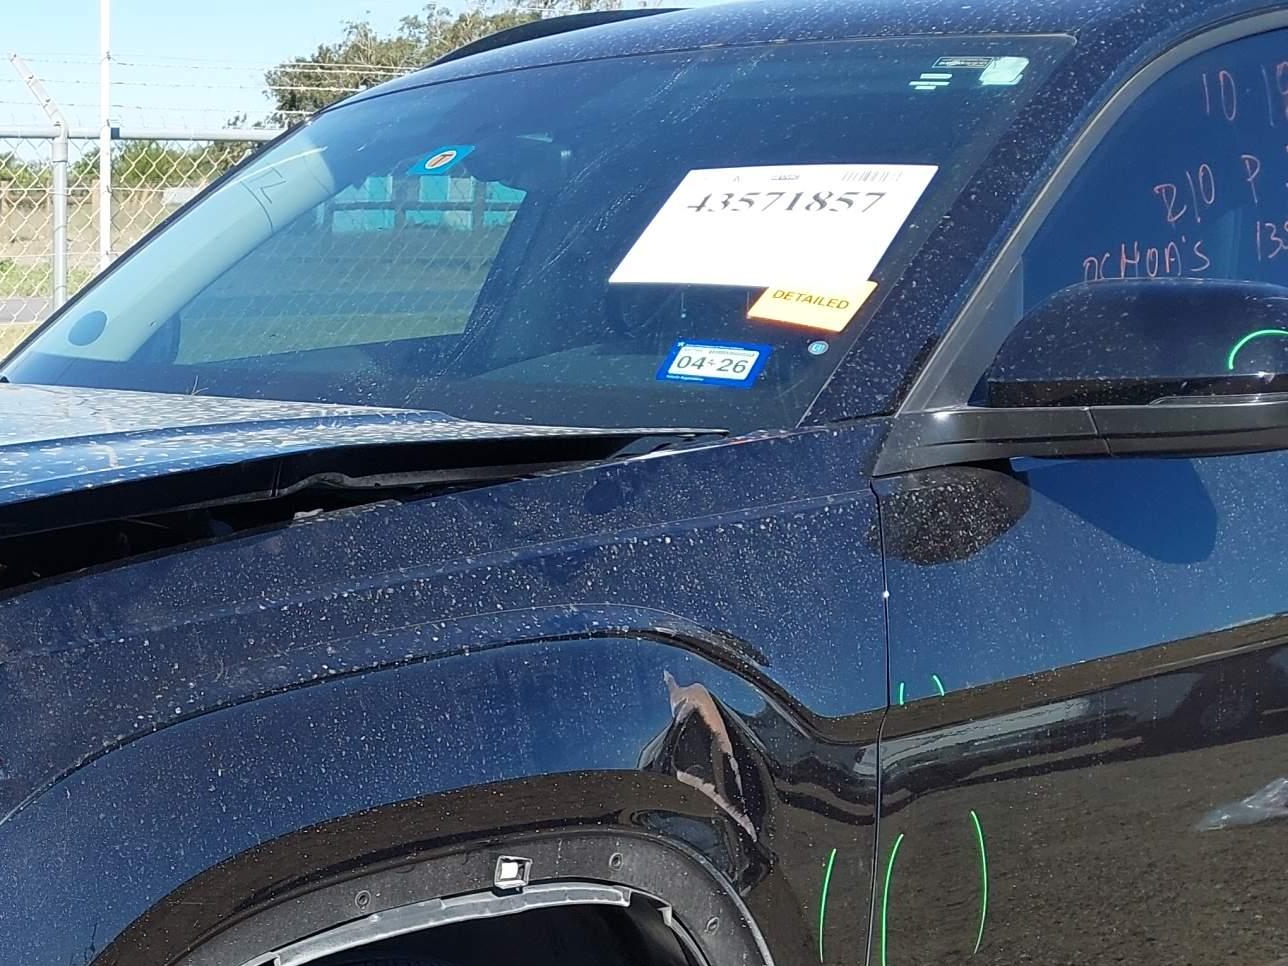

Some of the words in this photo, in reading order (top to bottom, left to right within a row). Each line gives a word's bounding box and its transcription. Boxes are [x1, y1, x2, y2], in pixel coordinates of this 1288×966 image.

[686, 190, 888, 214] 43571857
[771, 288, 851, 312] DETAILED
[676, 354, 708, 370] 04
[716, 357, 749, 375] 26
